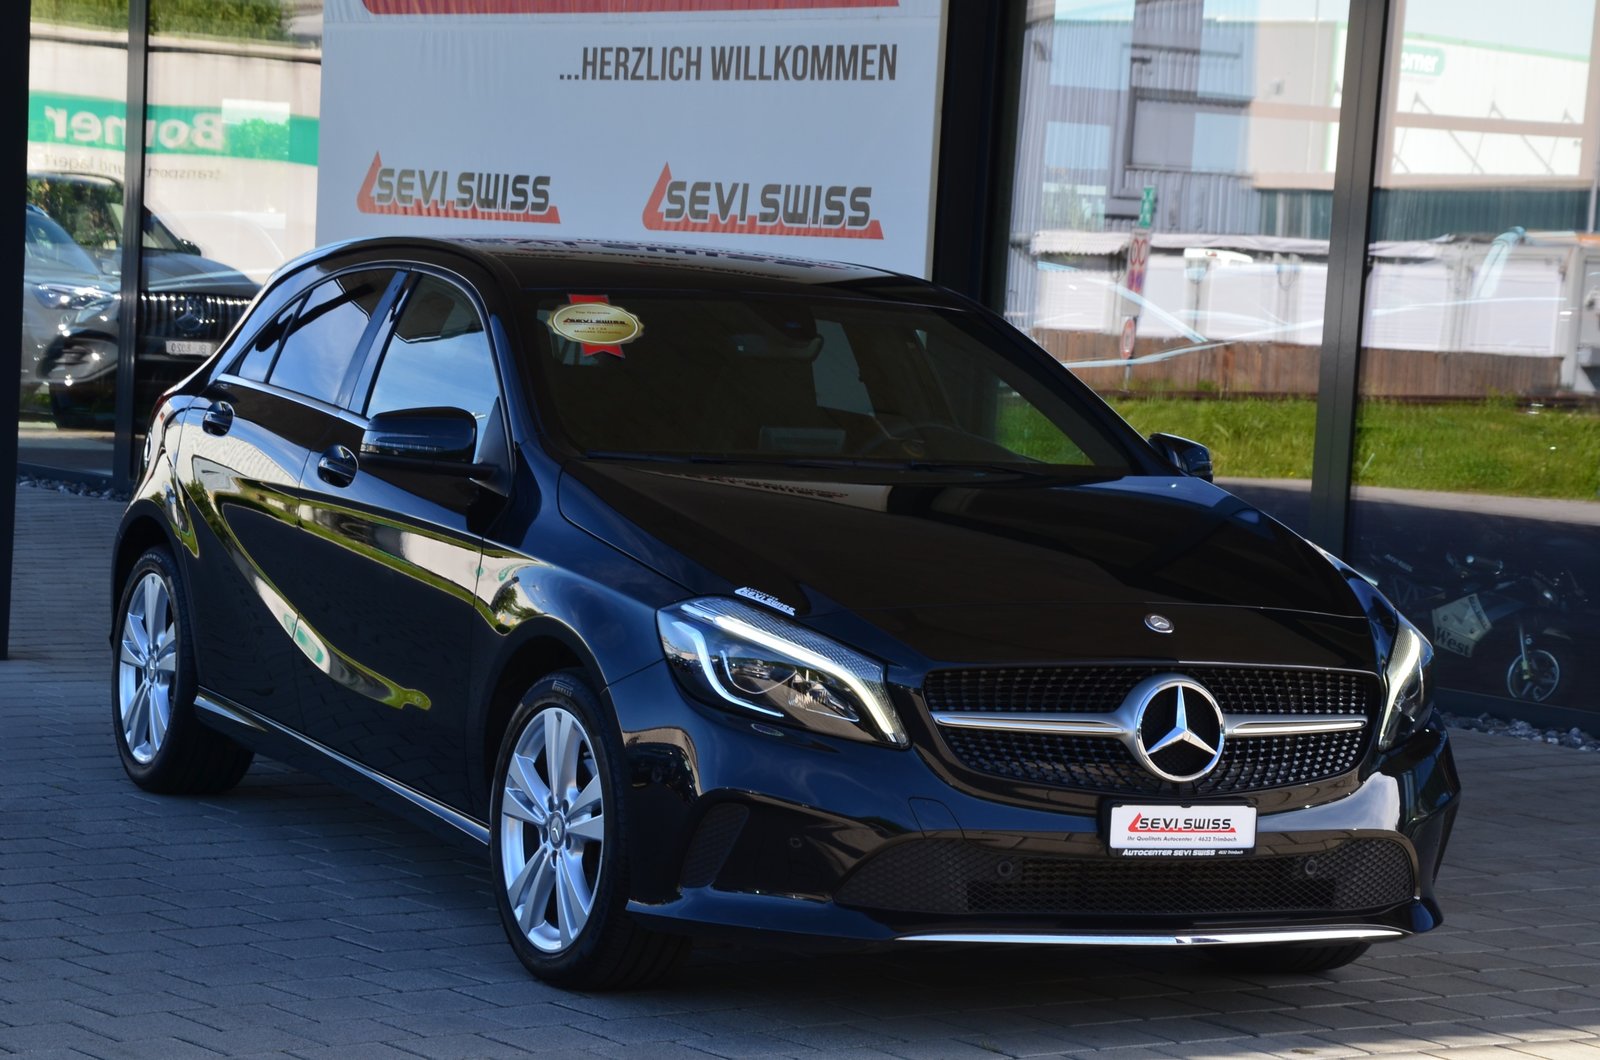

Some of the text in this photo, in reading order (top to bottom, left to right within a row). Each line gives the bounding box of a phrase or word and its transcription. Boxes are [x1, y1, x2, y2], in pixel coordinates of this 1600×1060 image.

[559, 44, 898, 81] ...HERZLICH WILLKOMMEN
[375, 168, 551, 213] SEVI SWISS
[664, 181, 872, 227] SEVI SWISS
[1138, 817, 1232, 830] SEVI SWISS
[1173, 849, 1192, 857] SEVI
[1192, 849, 1216, 857] SWISS
